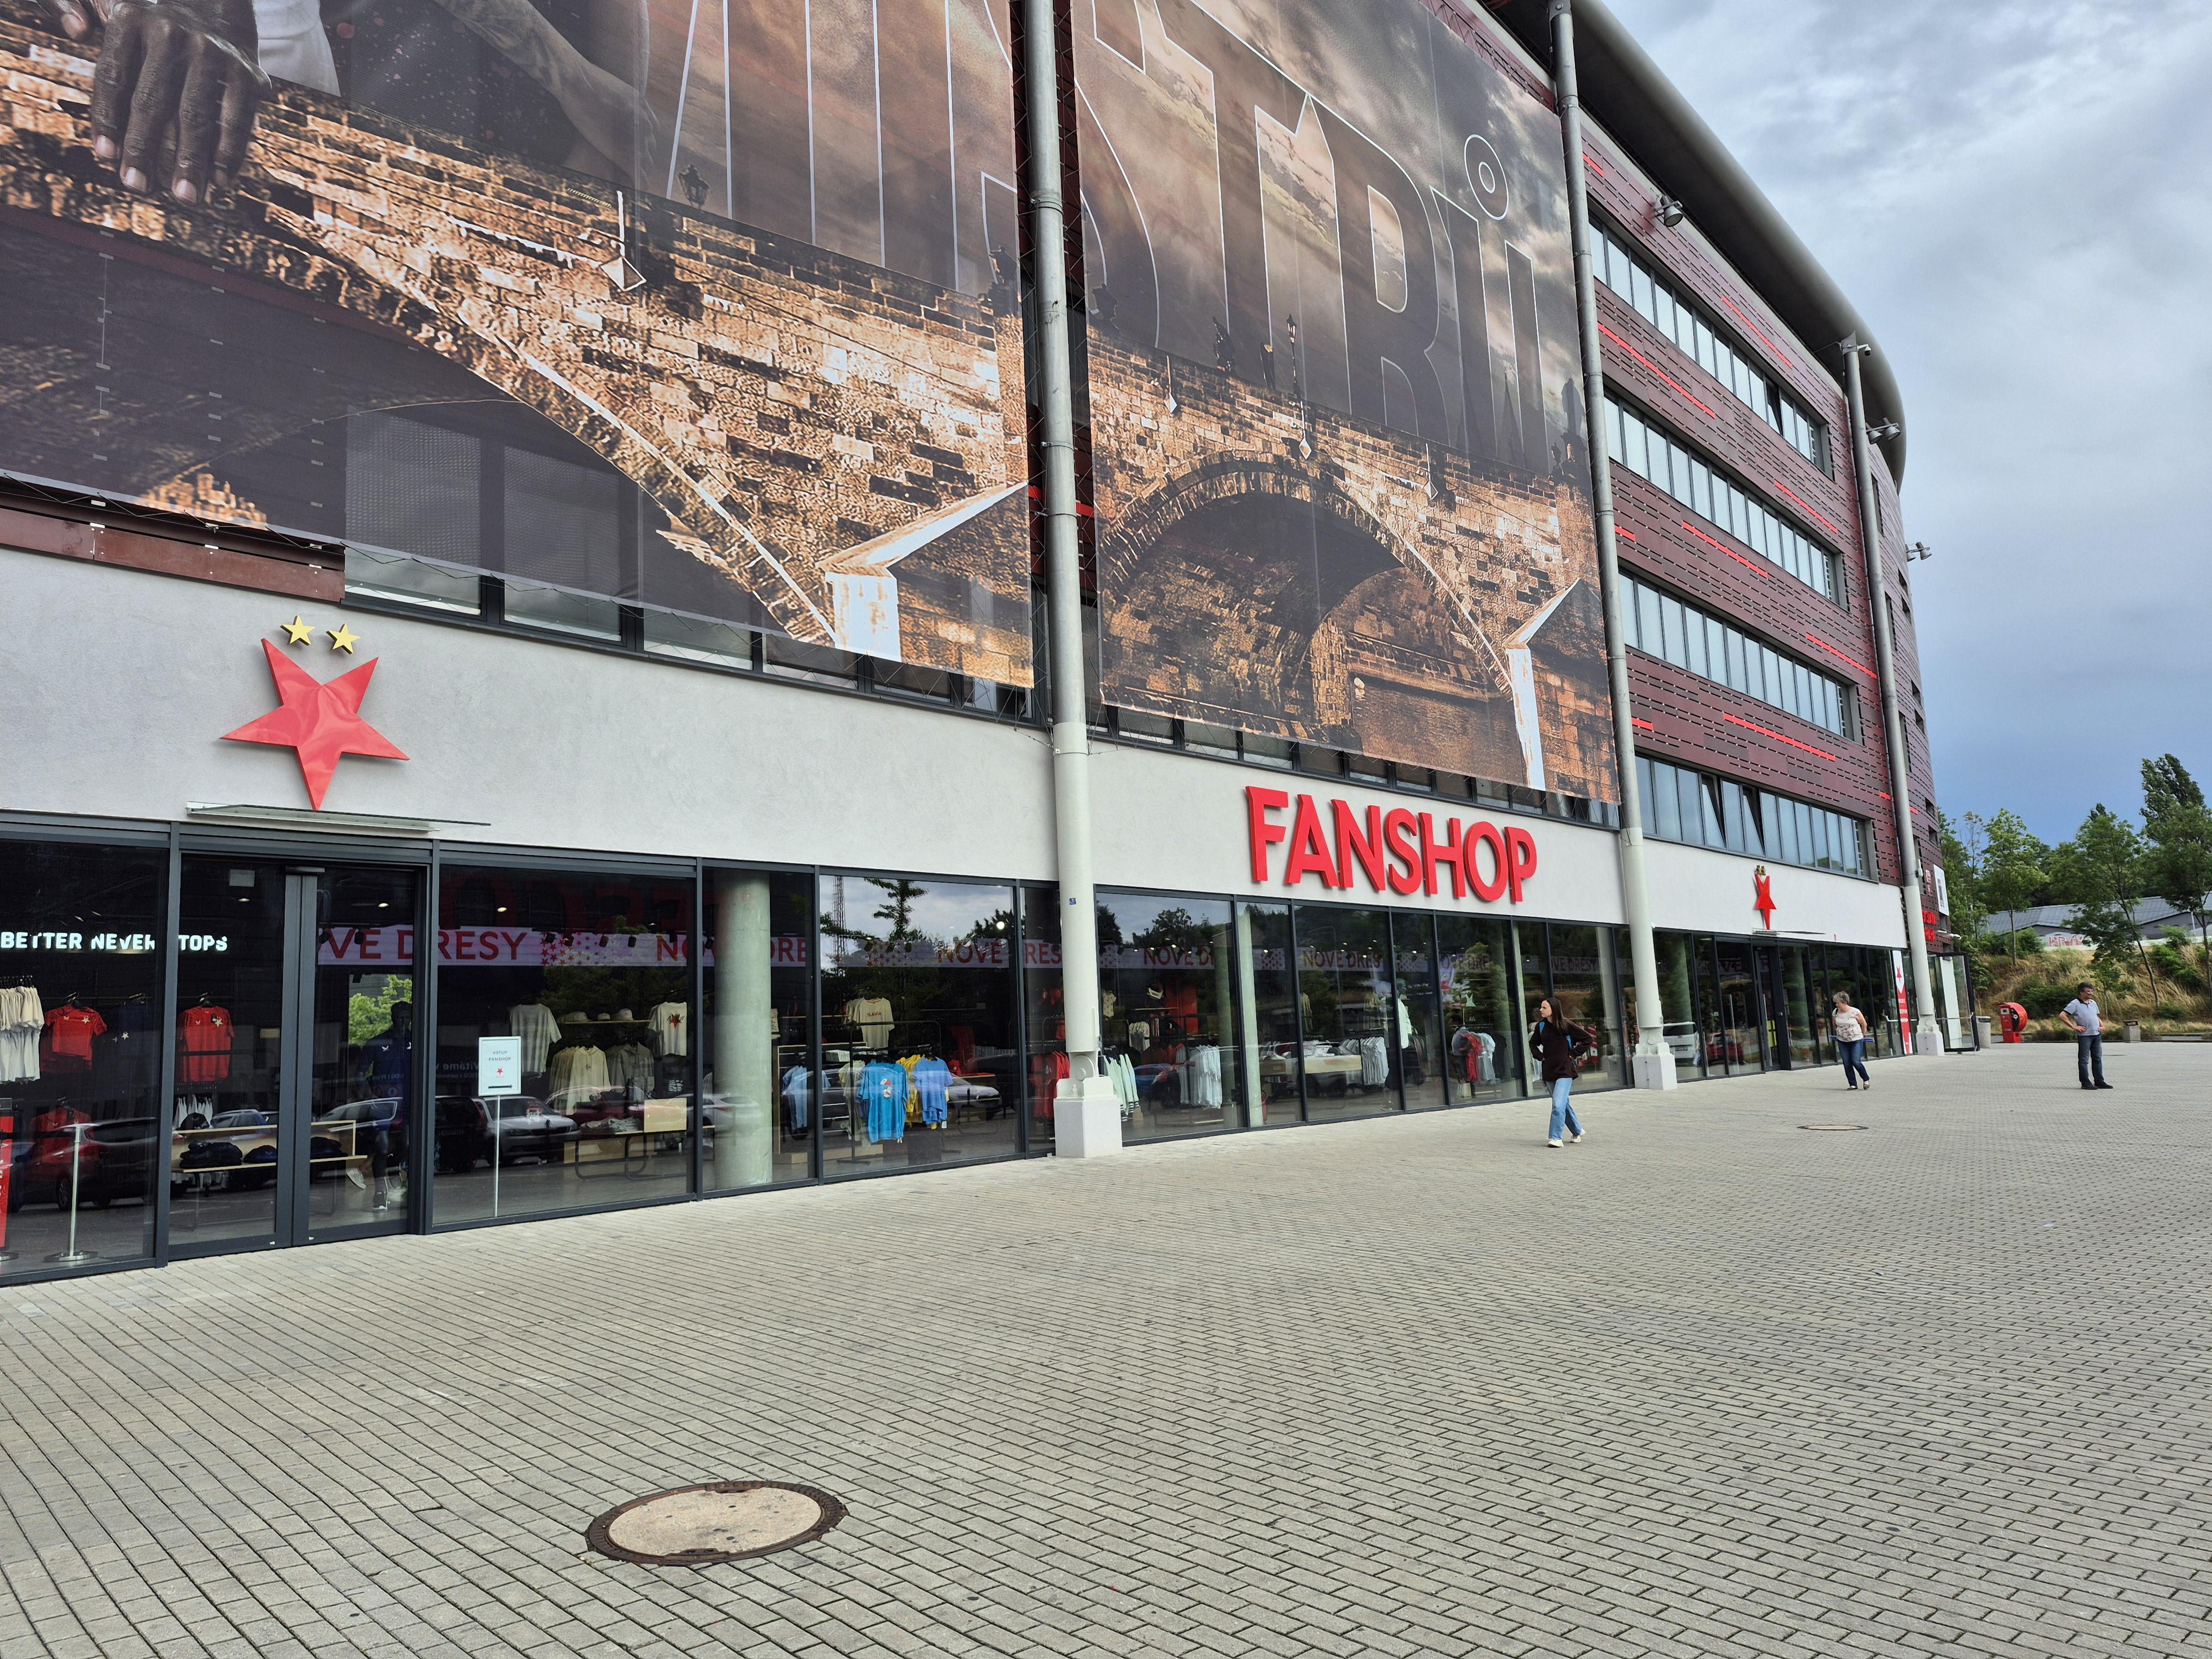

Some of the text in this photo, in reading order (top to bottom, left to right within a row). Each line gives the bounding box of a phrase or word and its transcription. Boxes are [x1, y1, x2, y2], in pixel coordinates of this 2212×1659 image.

[1245, 785, 1537, 903] FANSHOP
[1, 932, 82, 949] BETTER
[178, 935, 228, 951] TOPS
[1024, 942, 1062, 964] RES
[1144, 946, 1194, 966] NOVE
[1347, 950, 1383, 968] DRES
